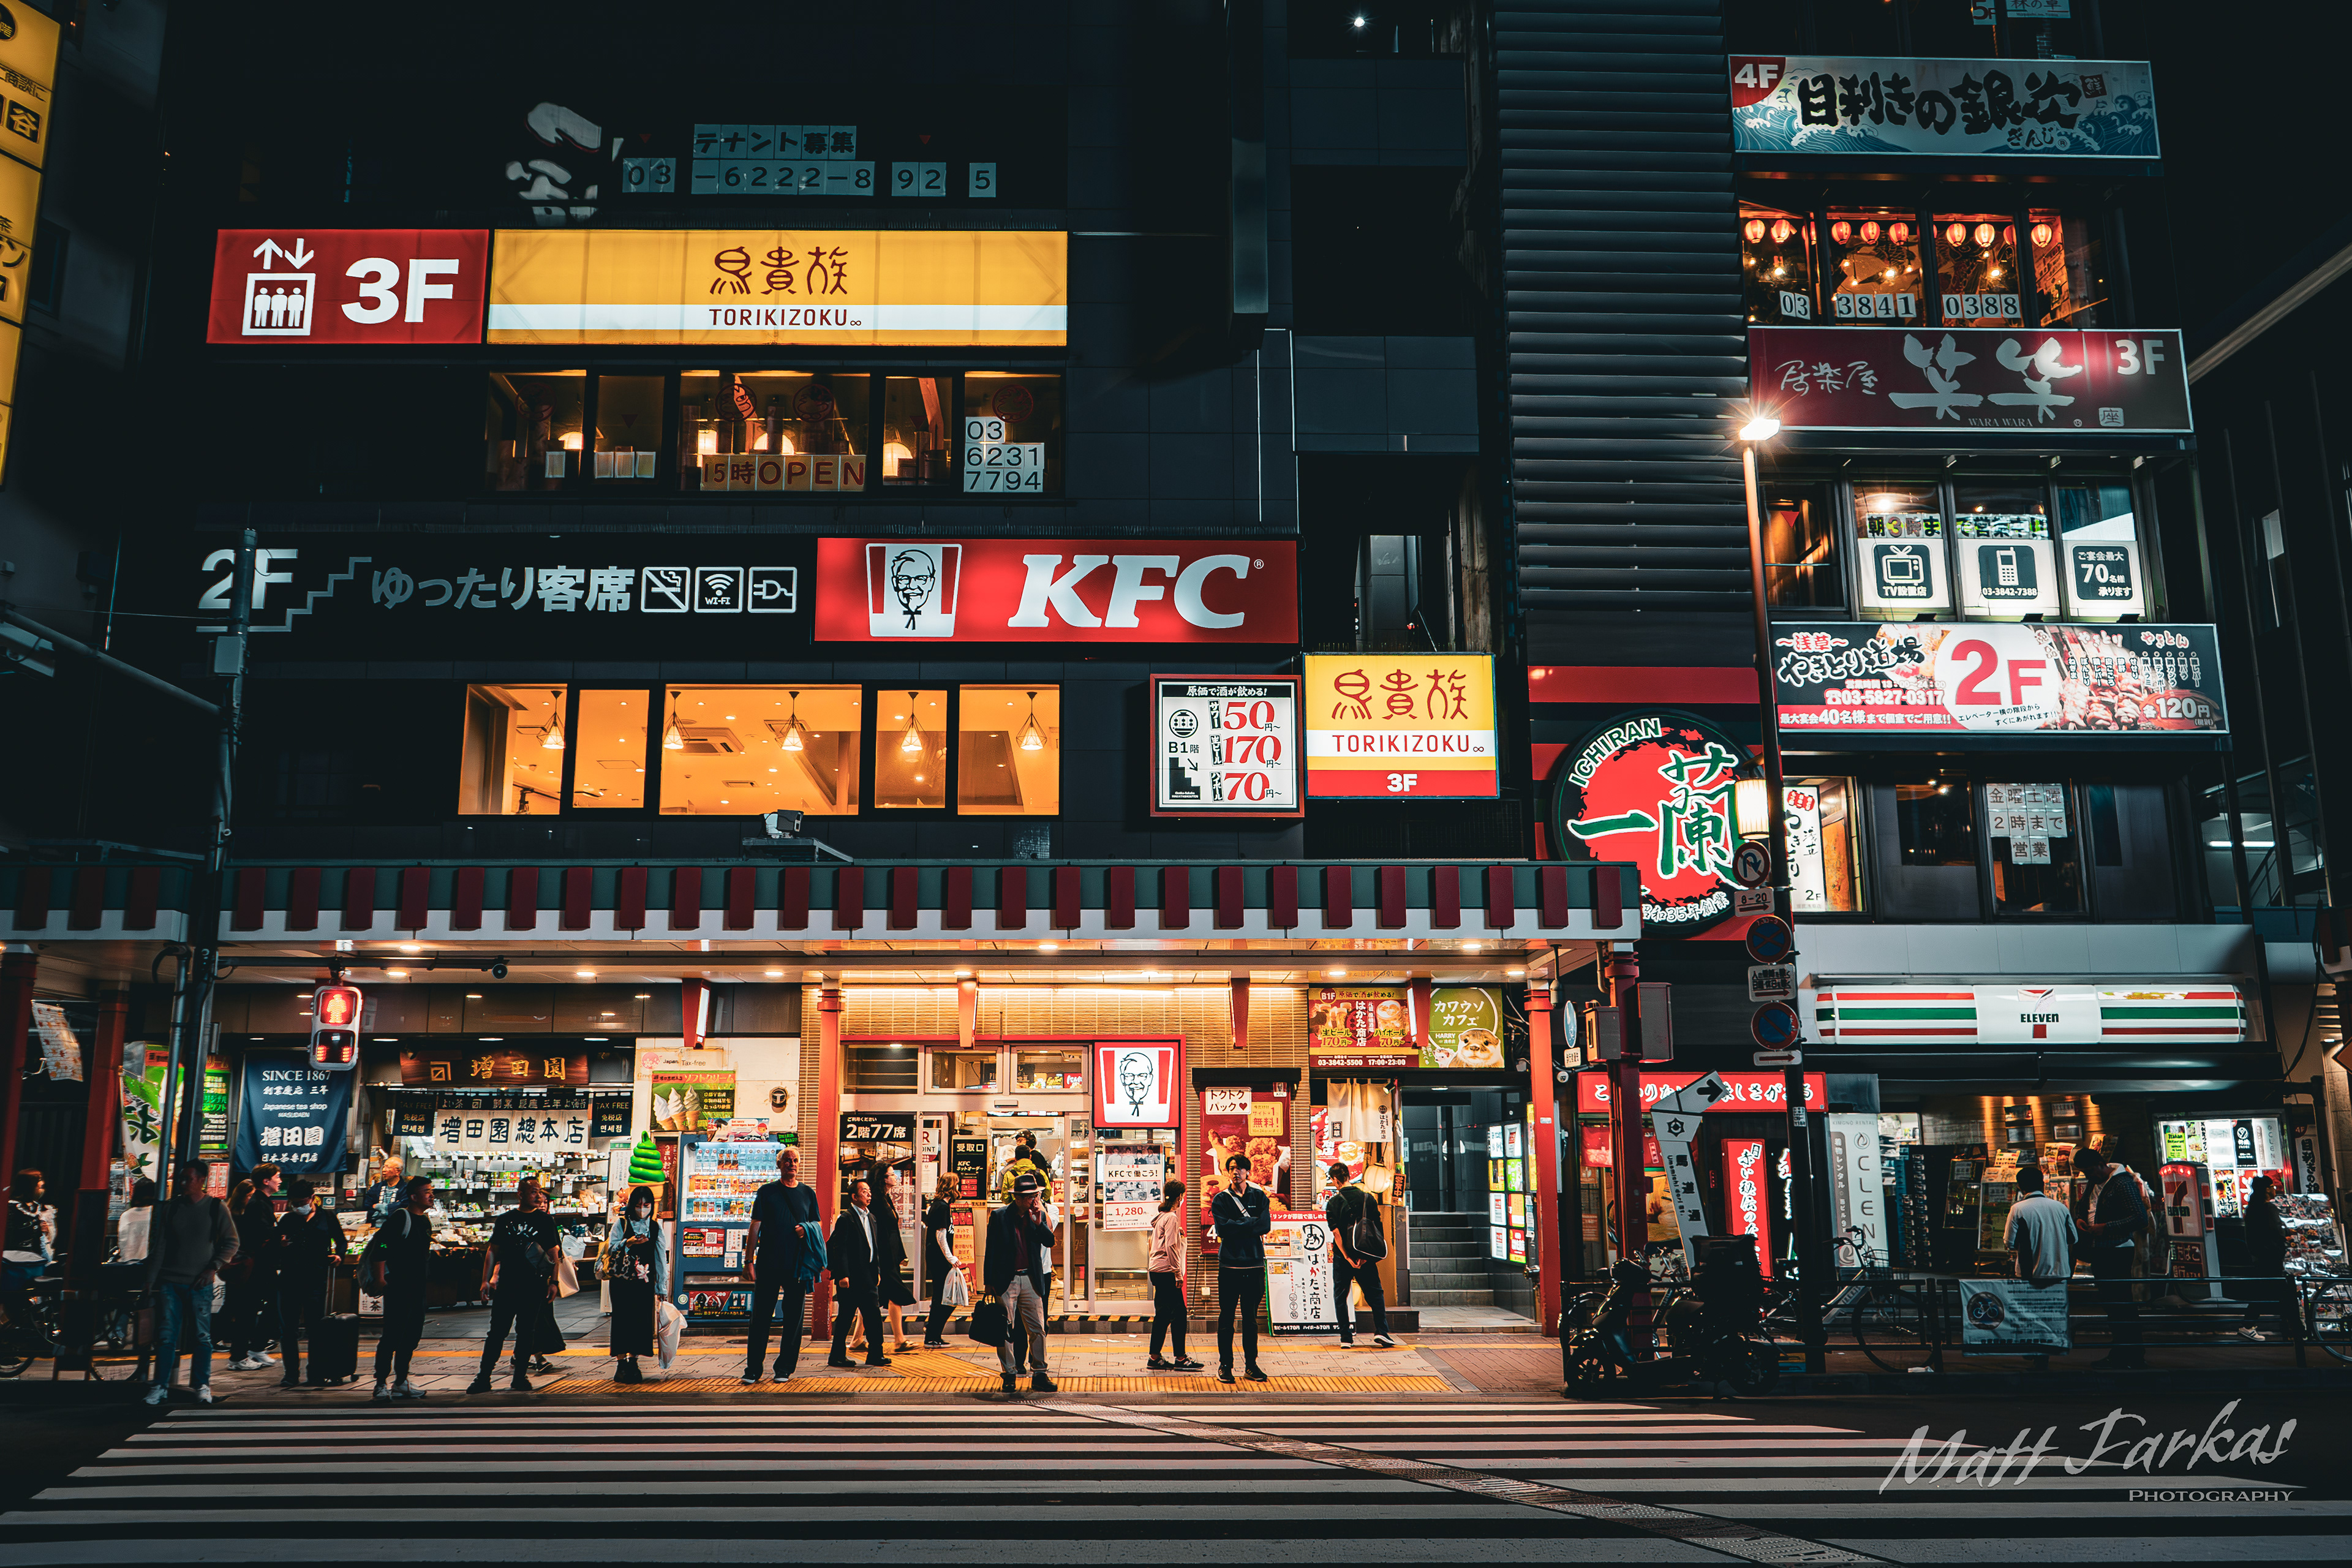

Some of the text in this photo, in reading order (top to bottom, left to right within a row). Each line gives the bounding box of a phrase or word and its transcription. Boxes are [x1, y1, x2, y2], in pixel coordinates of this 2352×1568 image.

[1735, 64, 1779, 88] 4F
[1797, 70, 2082, 135] 目利きの銀次
[695, 131, 854, 154] テナント募集
[2007, 127, 2054, 149] ぎんじ
[628, 165, 671, 186] 03
[898, 169, 943, 190] 92
[974, 170, 991, 190] 5
[709, 246, 849, 295] 鳥貴族
[341, 257, 459, 324] 3F
[1782, 294, 2019, 318] 03 3841 0388
[709, 309, 849, 327] TORIKIZOKU
[2115, 339, 2164, 375] 3F
[967, 421, 1004, 441] 03
[967, 448, 1039, 467] 6231
[967, 471, 1042, 490] 7794
[198, 548, 299, 609] 2F
[372, 565, 635, 612] ゆったり客席
[1007, 554, 1251, 629] KFC
[1983, 587, 2038, 597] 03-3842-7388
[2098, 587, 2132, 597] 承ります
[1777, 636, 1925, 687] やきとり道場
[1951, 639, 2047, 706] 2F
[1186, 685, 1268, 697] 原価で酒が飲める!
[1331, 669, 1468, 720] 鳥貴族
[1841, 690, 1945, 706] 03-5827-0317
[1209, 701, 1219, 728] サワー
[1169, 742, 1199, 754] B1階
[1211, 735, 1223, 764] 生ビール
[1332, 734, 1469, 752] TORIKIZOKU
[1569, 718, 1662, 788] ICHIRAN
[1211, 772, 1223, 801] ハイボール
[1387, 773, 1418, 792] 3F
[1993, 815, 2064, 832] 2時まで
[2013, 842, 2048, 858] 営業
[1741, 892, 1768, 904] 8-20
[1805, 889, 1822, 901] 2F
[1434, 1000, 1484, 1013] カワウソ
[1355, 1001, 1366, 1047] はかた商店
[1442, 1014, 1478, 1026] カフェ
[1322, 1028, 1352, 1037] 生ビール
[262, 1070, 331, 1081] SINCE 1867
[684, 1074, 734, 1083] ソフトクリーム
[309, 1085, 329, 1095] 三年
[1210, 1090, 1245, 1100] トクトク
[1210, 1102, 1237, 1111] パック
[846, 1124, 907, 1139] 2階77席
[1253, 1117, 1279, 1128] 無料!
[956, 1143, 984, 1152] 受取口
[262, 1152, 319, 1163] 日本茶専門店
[1308, 1253, 1321, 1319] はかた商店
